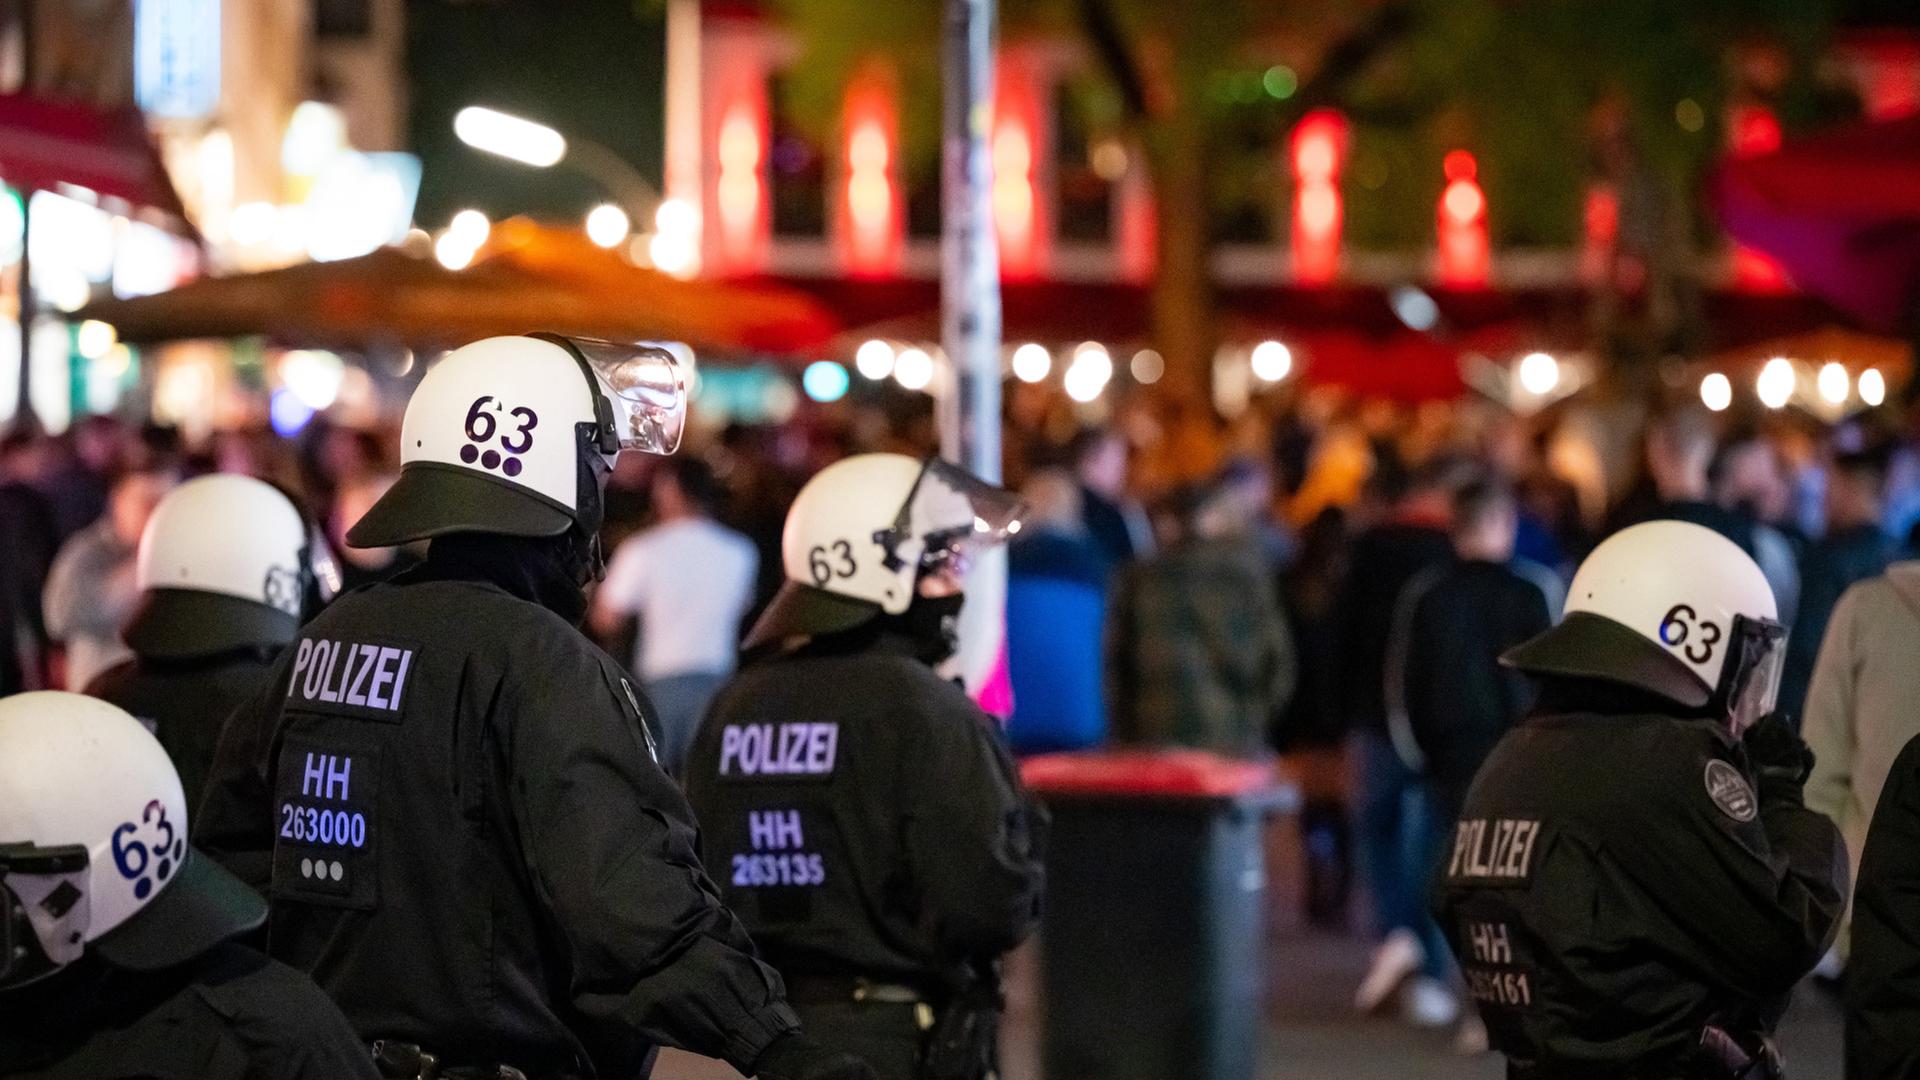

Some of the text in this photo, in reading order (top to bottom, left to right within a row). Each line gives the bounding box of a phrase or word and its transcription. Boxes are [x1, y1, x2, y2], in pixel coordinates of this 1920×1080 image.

[464, 395, 538, 455] 63
[809, 538, 856, 584] 63
[1659, 604, 1720, 664] 63
[287, 638, 413, 711] POLIZEI
[719, 722, 839, 775] POLIZEI
[302, 752, 351, 801] HH
[111, 799, 173, 879] 63
[280, 803, 366, 848] 263000
[750, 809, 803, 850] HH
[1448, 818, 1541, 878] POLIZEI
[731, 853, 825, 887] 263135
[1471, 922, 1512, 964] HH
